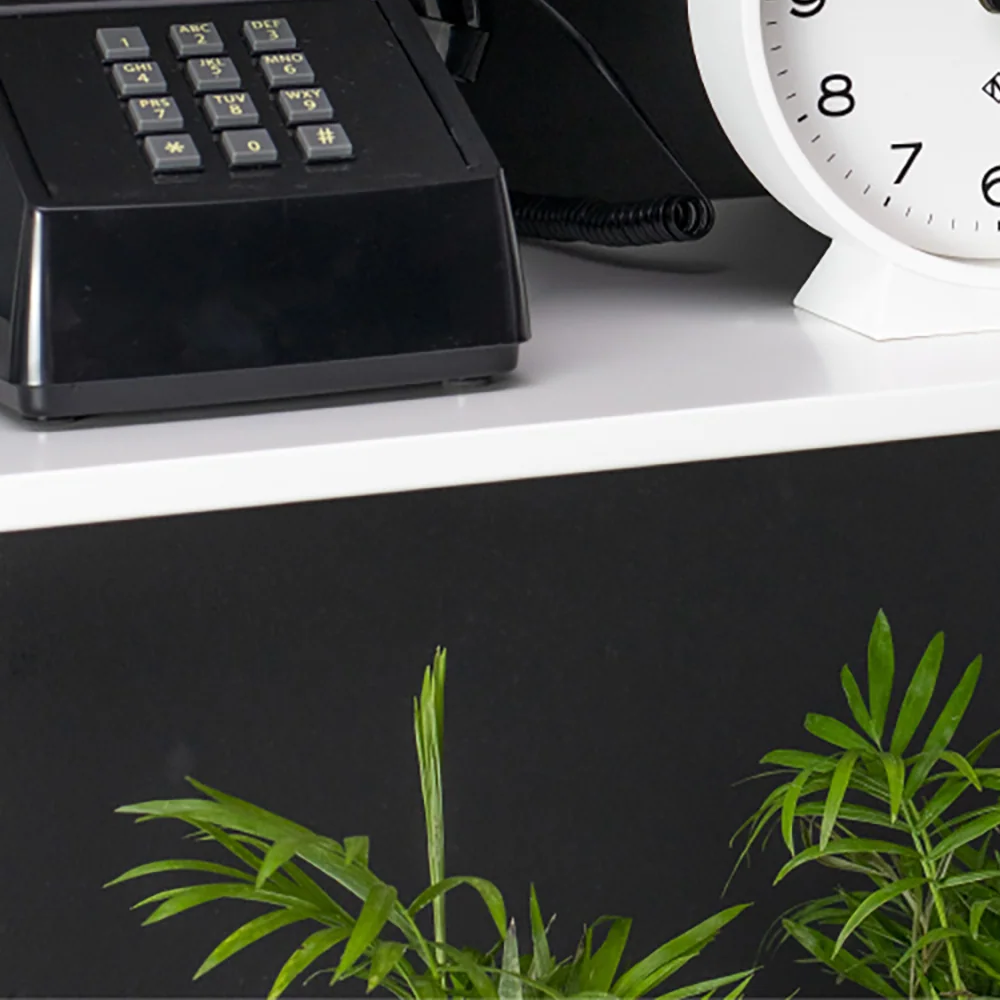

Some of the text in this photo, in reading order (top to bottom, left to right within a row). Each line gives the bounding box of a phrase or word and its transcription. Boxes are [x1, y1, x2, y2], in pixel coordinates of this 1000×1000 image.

[180, 23, 211, 34] ABC
[251, 19, 280, 29] DEF
[194, 33, 207, 46] 2
[267, 29, 280, 41] 3
[120, 37, 130, 48] 1
[264, 53, 304, 65] MNO
[123, 62, 153, 73] GHI
[210, 64, 222, 76] 5
[283, 63, 297, 75] 6
[137, 72, 150, 84] 4
[212, 93, 246, 105] TUV
[284, 88, 322, 100] WXY
[817, 73, 856, 118] 8
[139, 97, 171, 108] PRS
[303, 99, 317, 112] 9
[153, 108, 166, 120] 7
[229, 104, 243, 116] 8
[316, 127, 336, 145] #
[890, 141, 923, 185] 7
